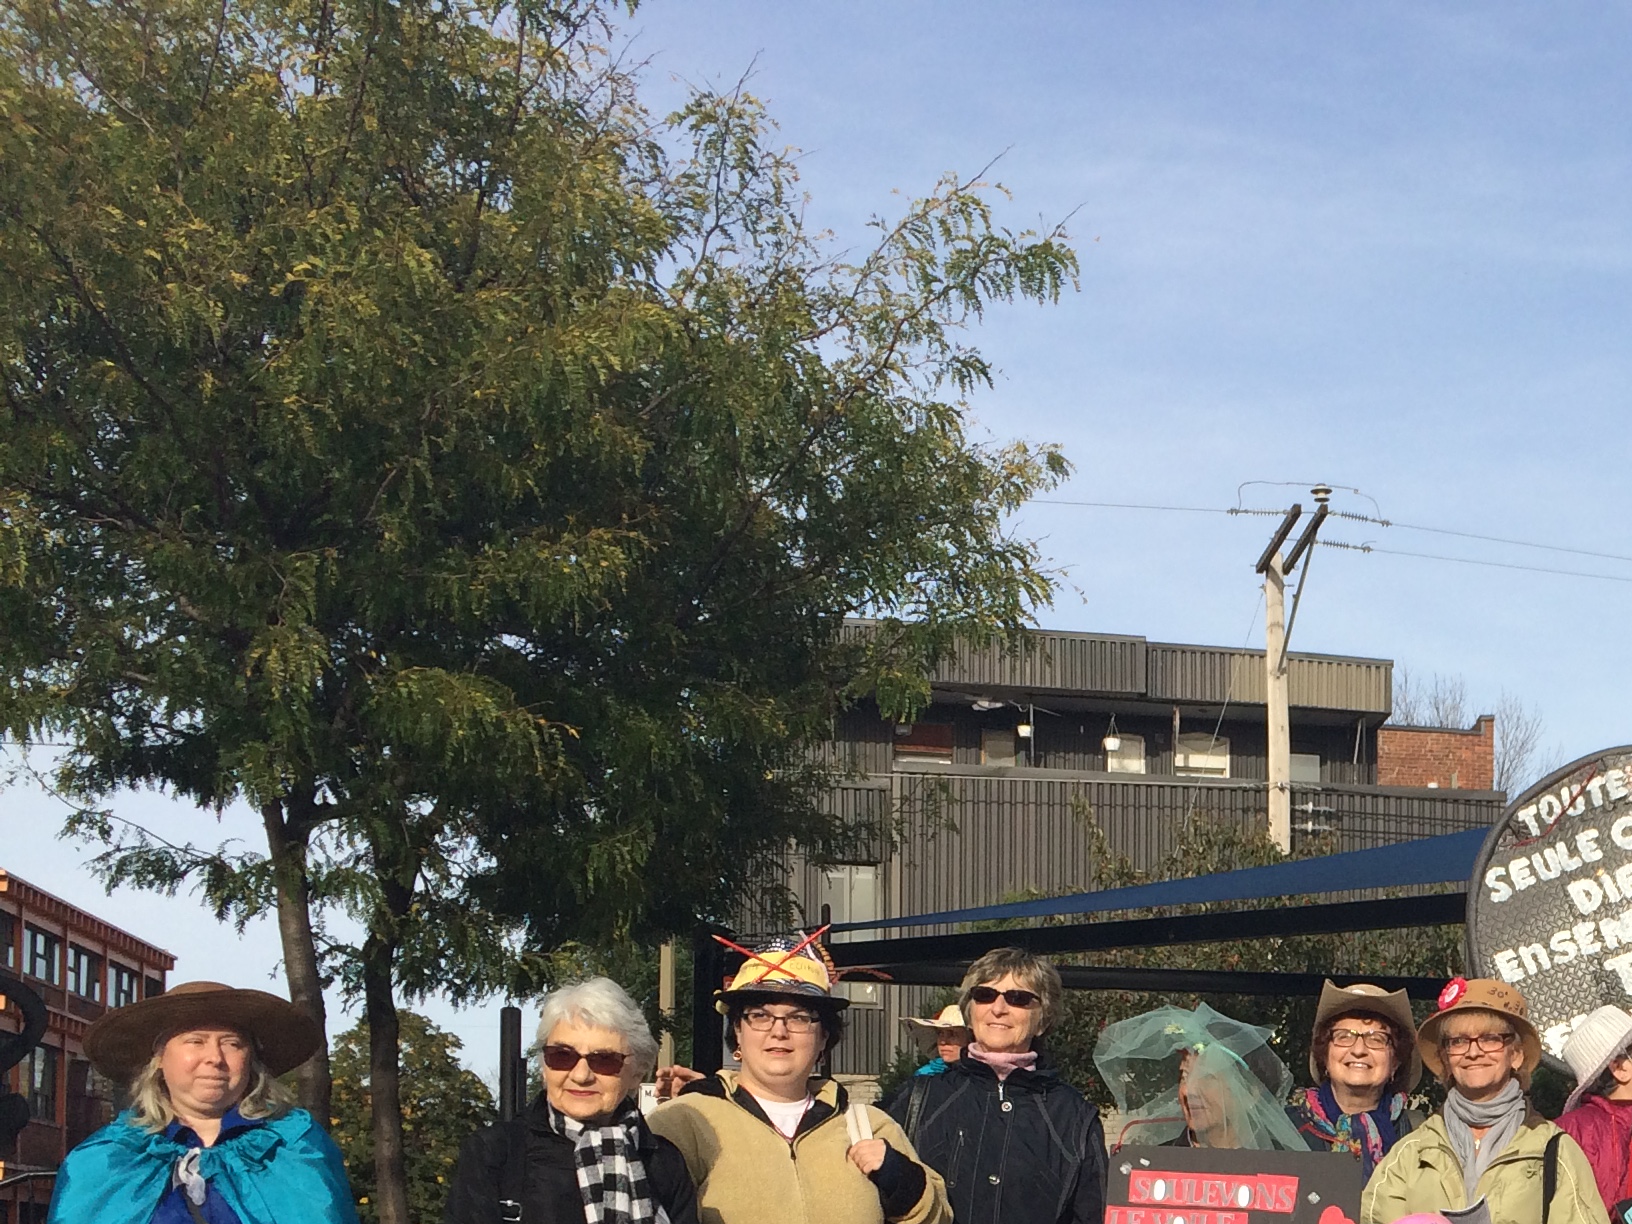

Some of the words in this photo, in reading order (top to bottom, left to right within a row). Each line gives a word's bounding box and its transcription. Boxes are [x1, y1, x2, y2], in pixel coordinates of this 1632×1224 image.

[1518, 769, 1630, 837] TOUTE
[1485, 829, 1603, 903] SEULE
[1132, 1177, 1298, 1212] SOULEVONS
